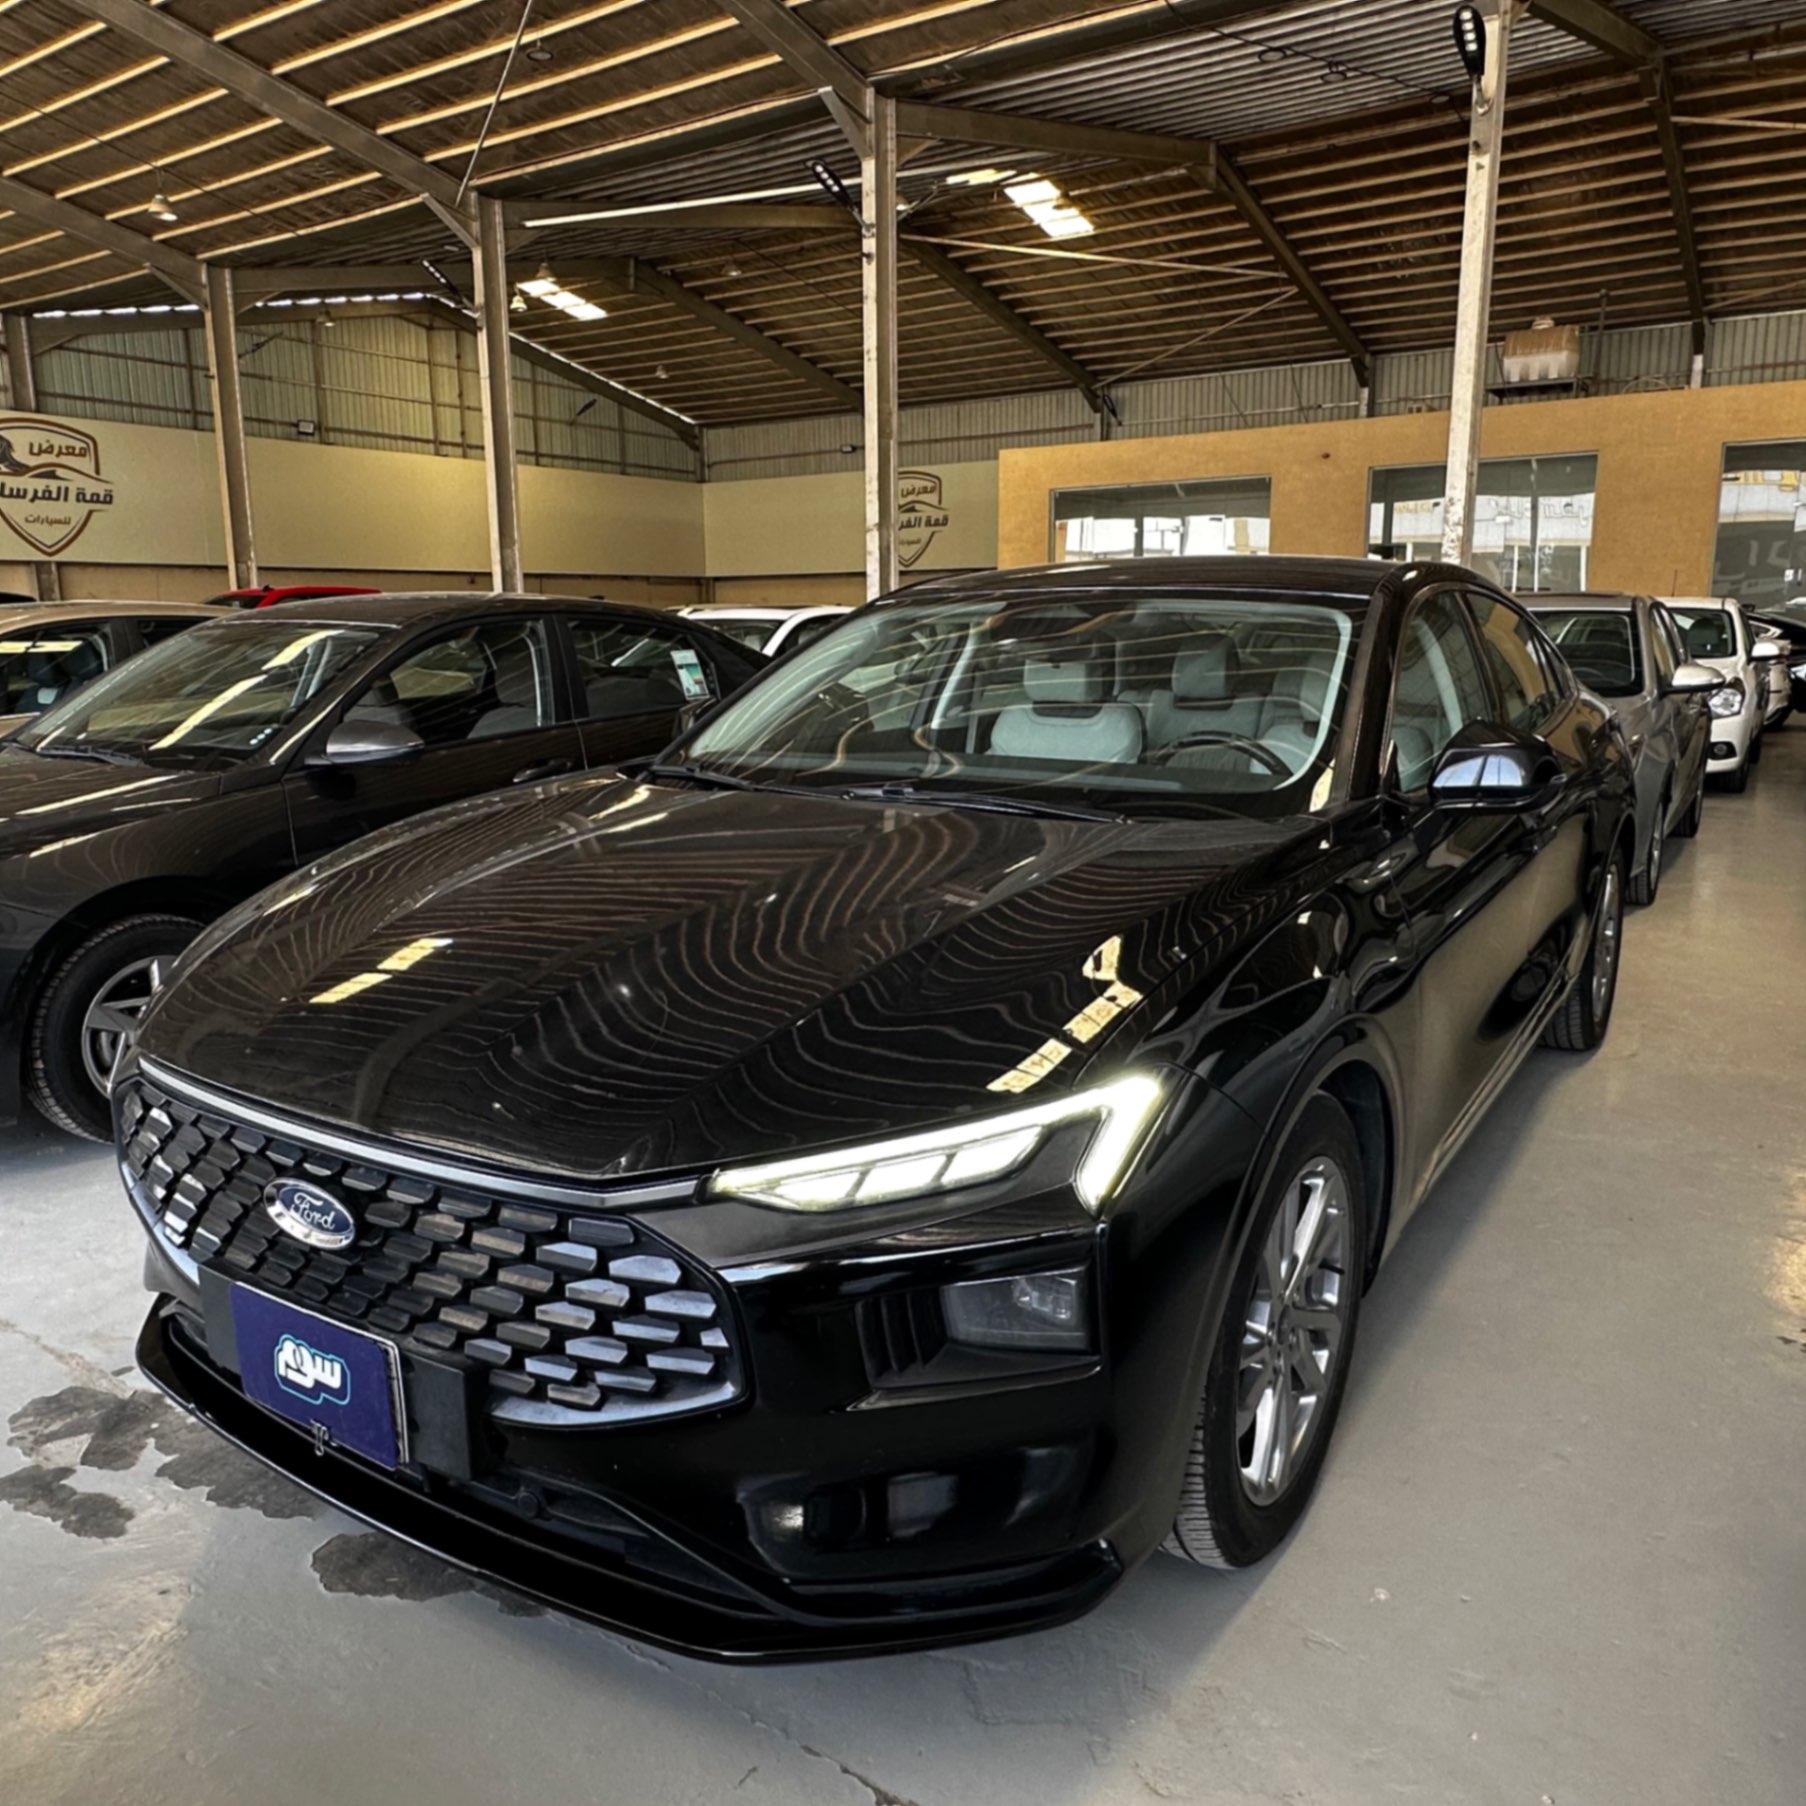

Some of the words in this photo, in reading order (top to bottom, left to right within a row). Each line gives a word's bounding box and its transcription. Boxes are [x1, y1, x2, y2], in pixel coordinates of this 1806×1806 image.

[29, 439, 88, 459] معرض
[0, 482, 69, 504] الفرسا
[75, 486, 113, 506] قمة
[24, 513, 71, 527] للسيارات
[898, 516, 922, 531] الفر
[290, 1191, 336, 1230] Ford
